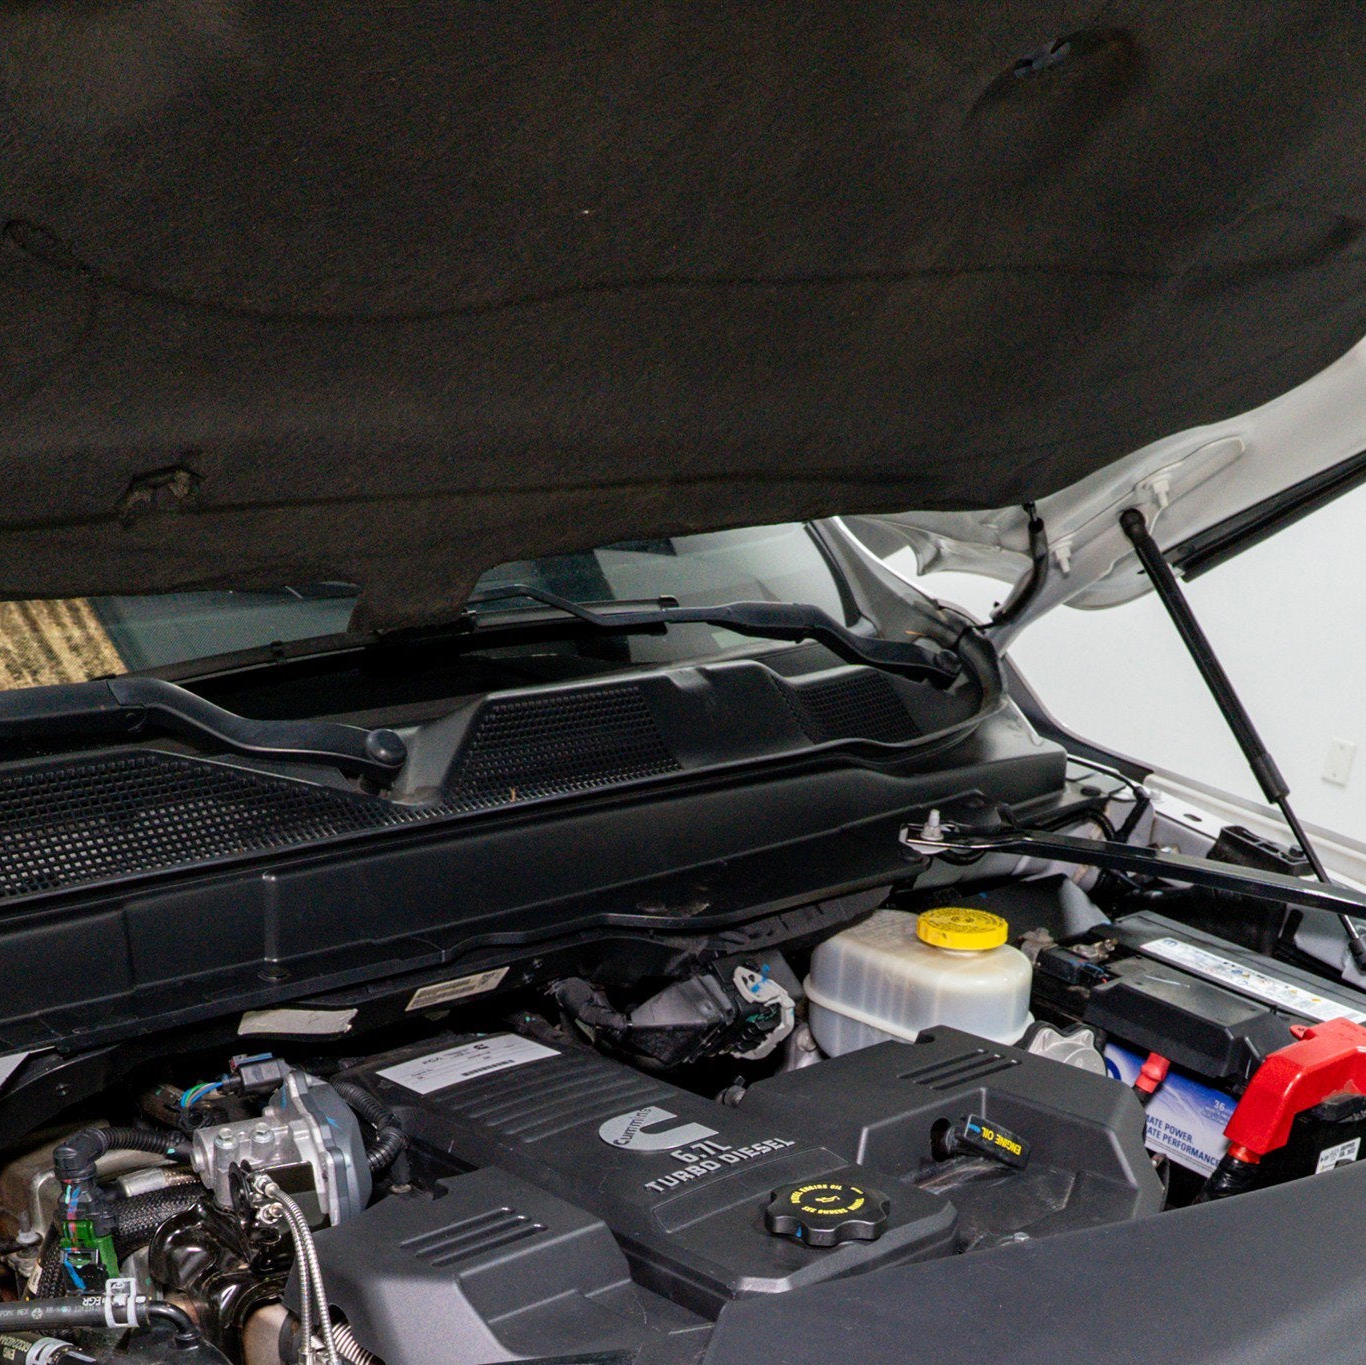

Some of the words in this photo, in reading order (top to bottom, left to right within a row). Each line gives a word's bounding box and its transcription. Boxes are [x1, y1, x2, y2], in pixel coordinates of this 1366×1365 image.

[1213, 1099, 1226, 1111] 36
[613, 1107, 652, 1146] Cummins
[981, 1126, 995, 1141] OIL
[670, 1140, 733, 1164] 6.7L
[995, 1134, 1022, 1156] ENGINE
[645, 1160, 722, 1193] TURBO
[718, 1137, 796, 1165] DIESEL
